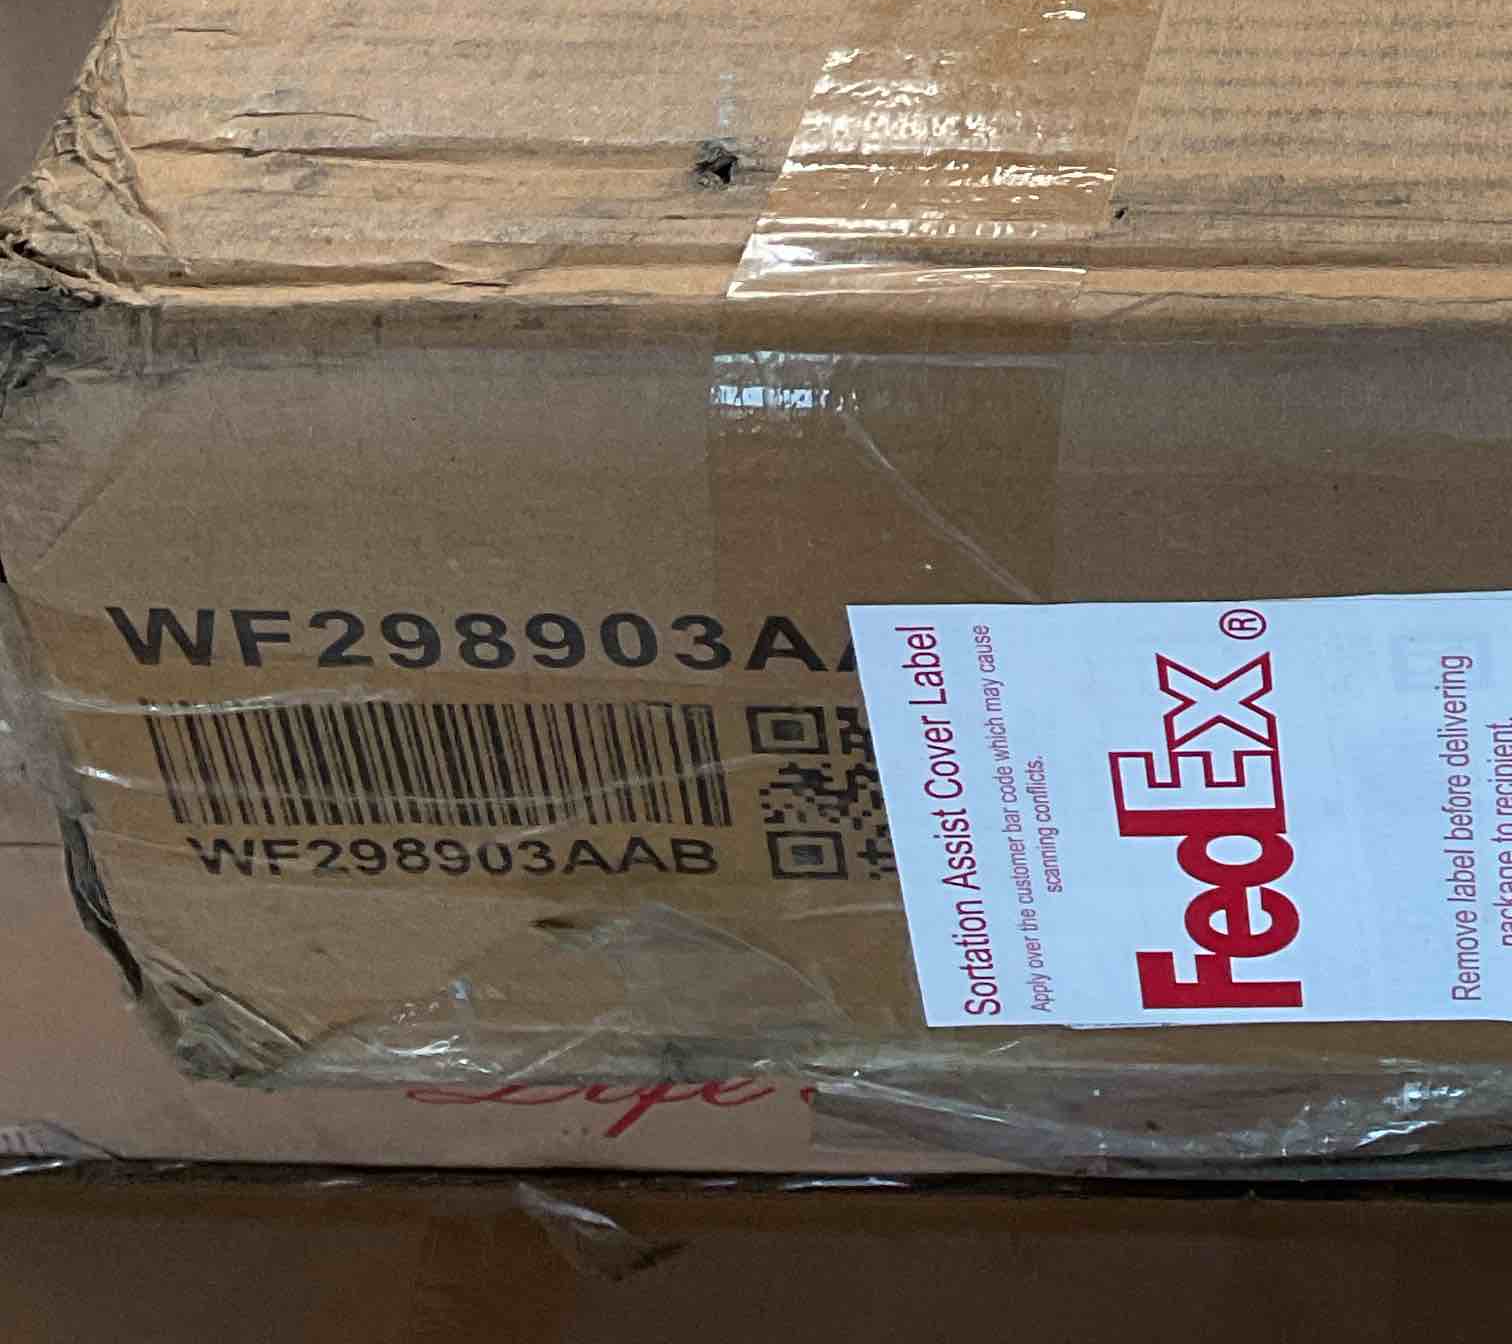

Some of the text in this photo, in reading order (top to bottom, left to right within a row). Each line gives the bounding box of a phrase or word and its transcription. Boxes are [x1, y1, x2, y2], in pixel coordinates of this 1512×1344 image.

[105, 606, 858, 673] WF298903A
[188, 835, 721, 877] WF298903AAB
[895, 626, 1001, 1016] Sortation Assist Cover Label
[973, 624, 1052, 1012] Apply over the customer bar code which may cause
[1024, 755, 1062, 894] scanning conflicts.
[1109, 652, 1303, 1010] FedEx
[1434, 655, 1481, 1001] Remove label before delivering
